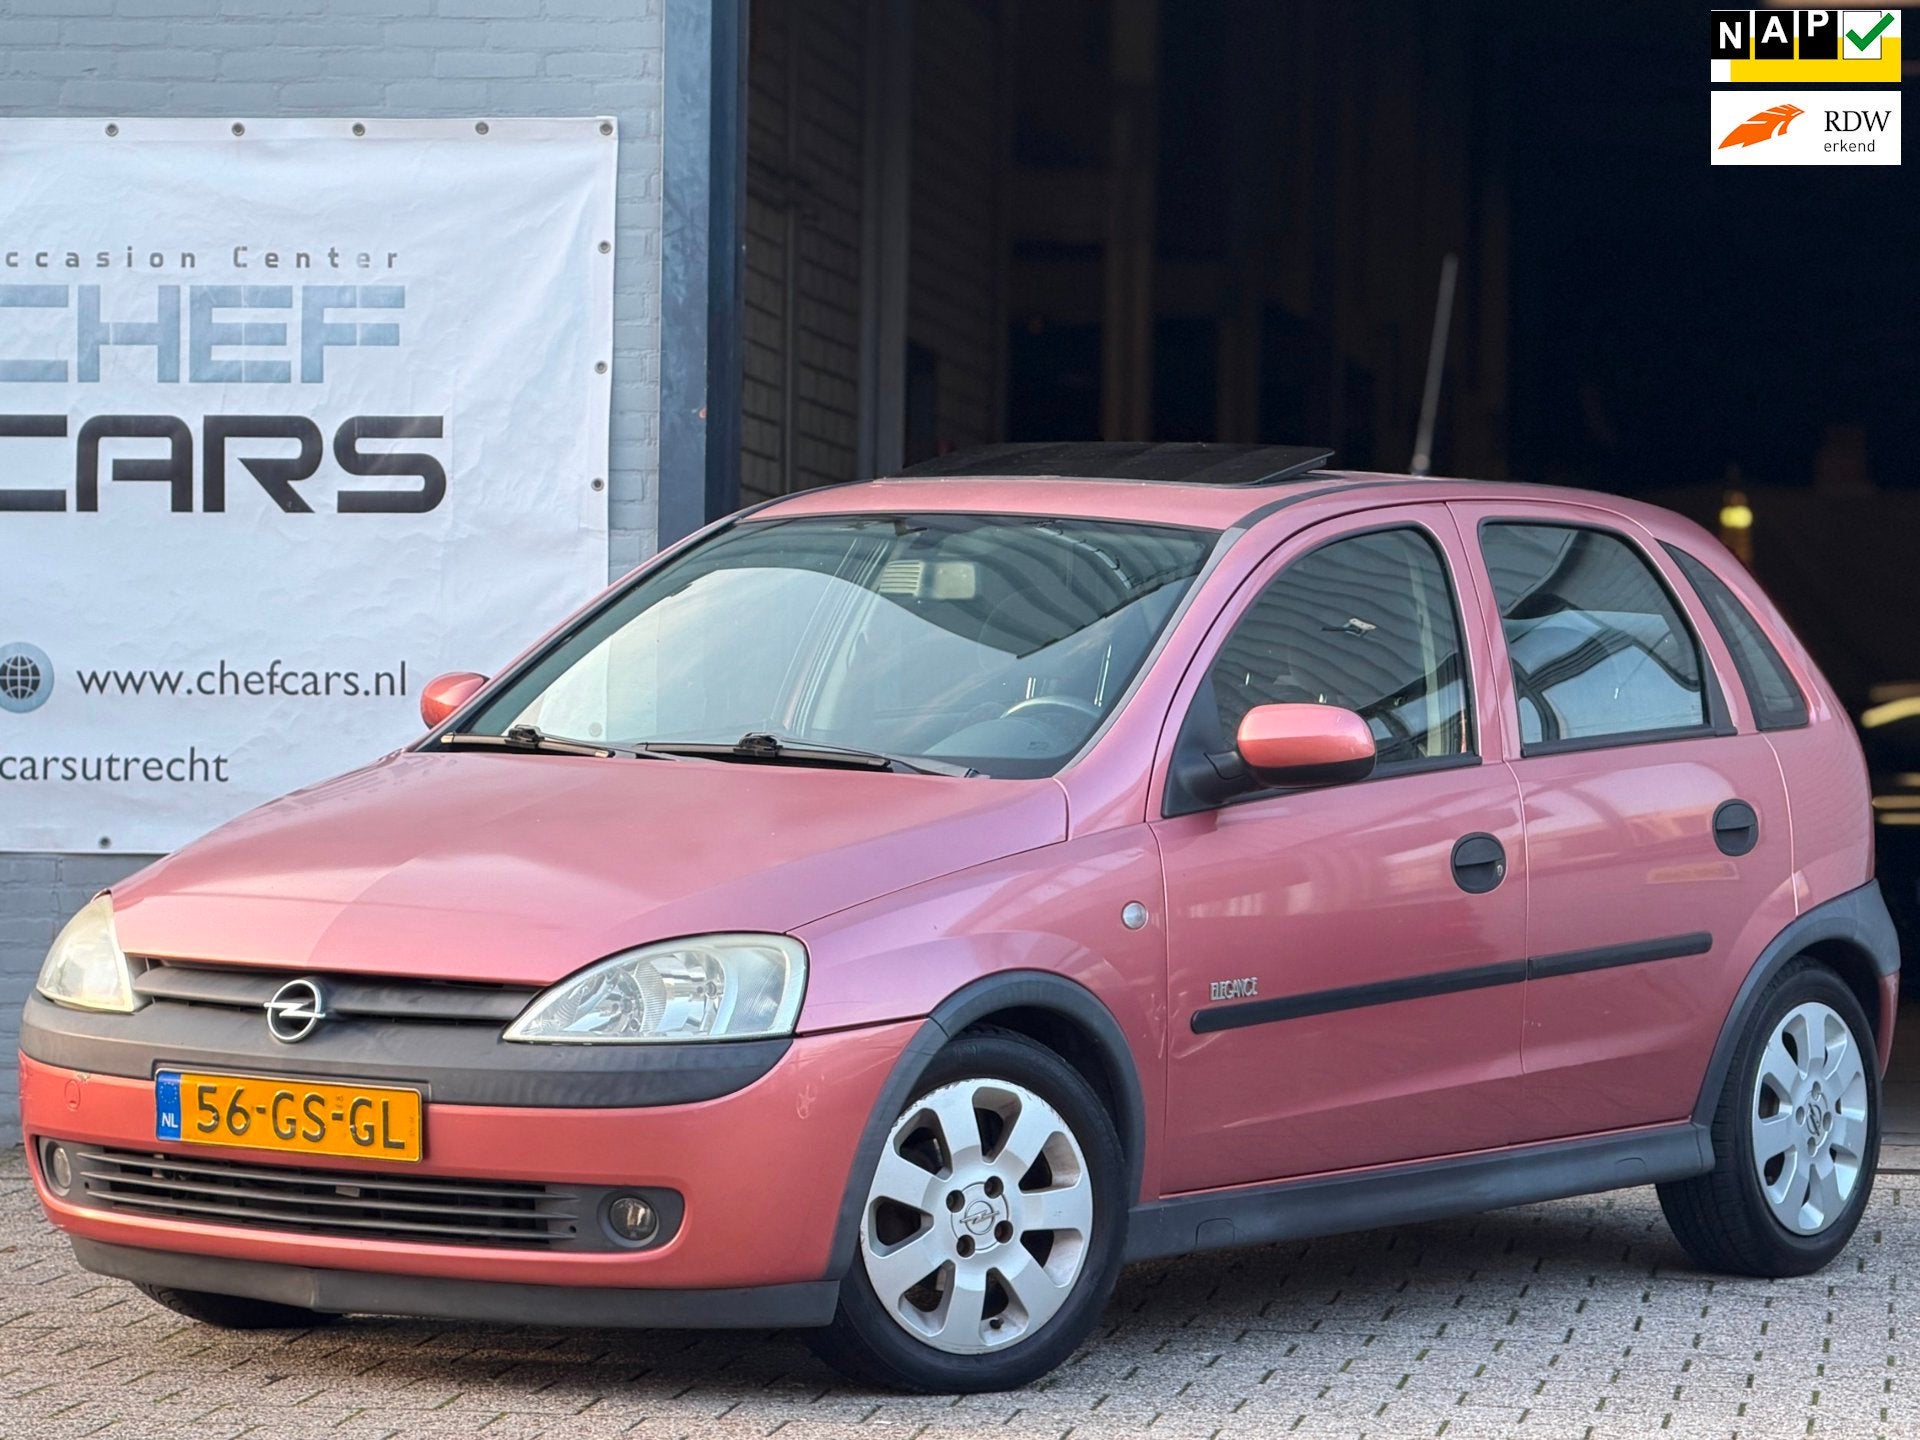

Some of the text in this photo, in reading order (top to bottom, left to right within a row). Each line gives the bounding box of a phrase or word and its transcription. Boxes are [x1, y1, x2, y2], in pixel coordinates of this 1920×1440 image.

[5, 246, 398, 268] ccasion Center
[0, 285, 405, 383] CHEF
[0, 414, 446, 513] CARS
[77, 660, 406, 696] www.chefcars.nl
[0, 747, 229, 783] carsutrecht
[1210, 977, 1258, 1001] ELEGANCE
[161, 1111, 179, 1129] NL
[196, 1084, 406, 1150] 56-GS-GL
